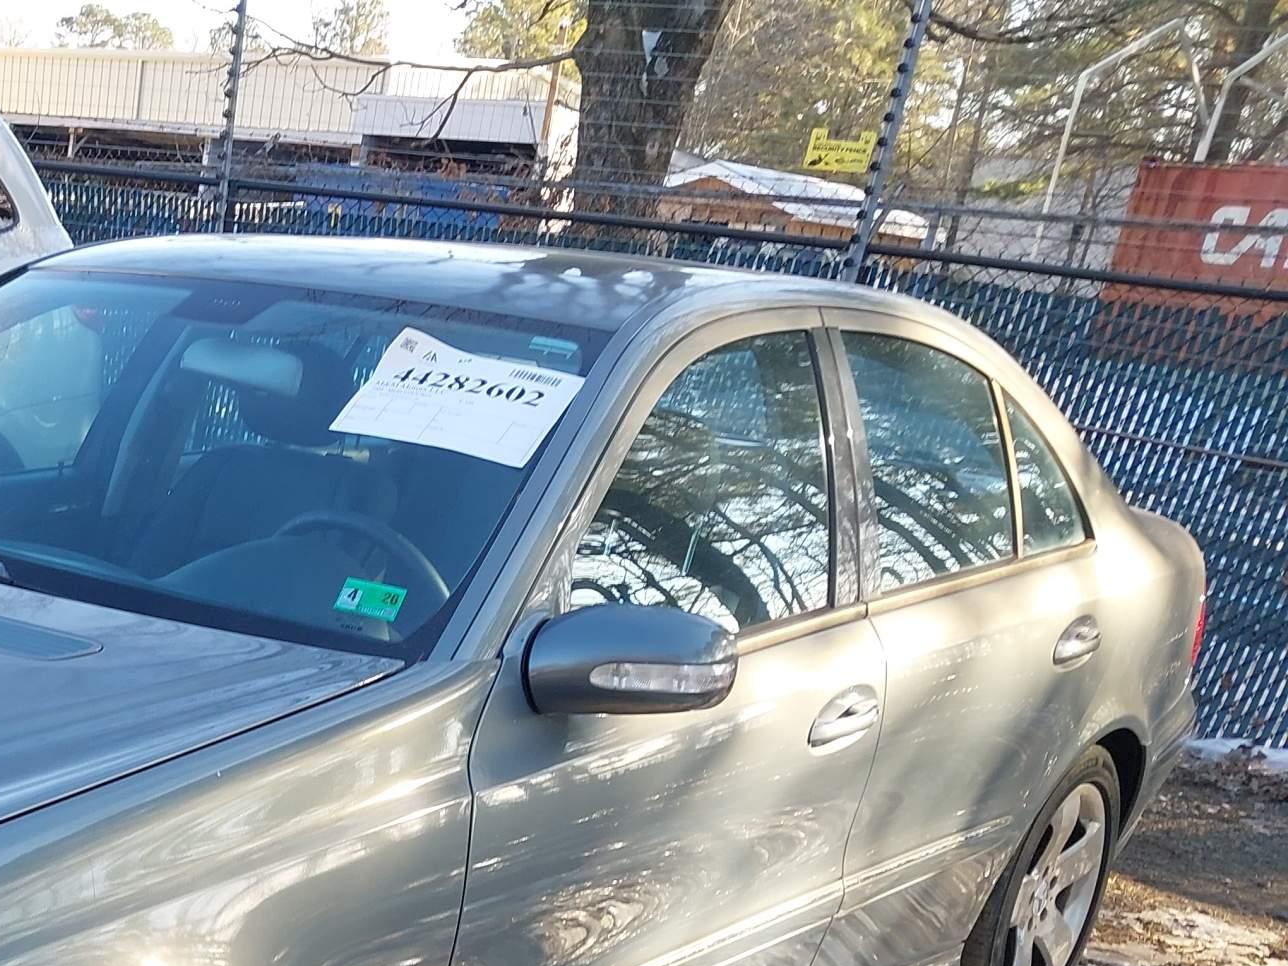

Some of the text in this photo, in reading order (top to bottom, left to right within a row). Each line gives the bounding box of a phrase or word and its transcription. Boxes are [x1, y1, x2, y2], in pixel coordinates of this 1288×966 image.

[1200, 206, 1288, 269] CA
[393, 367, 545, 406] 44282602
[347, 587, 359, 602] 4
